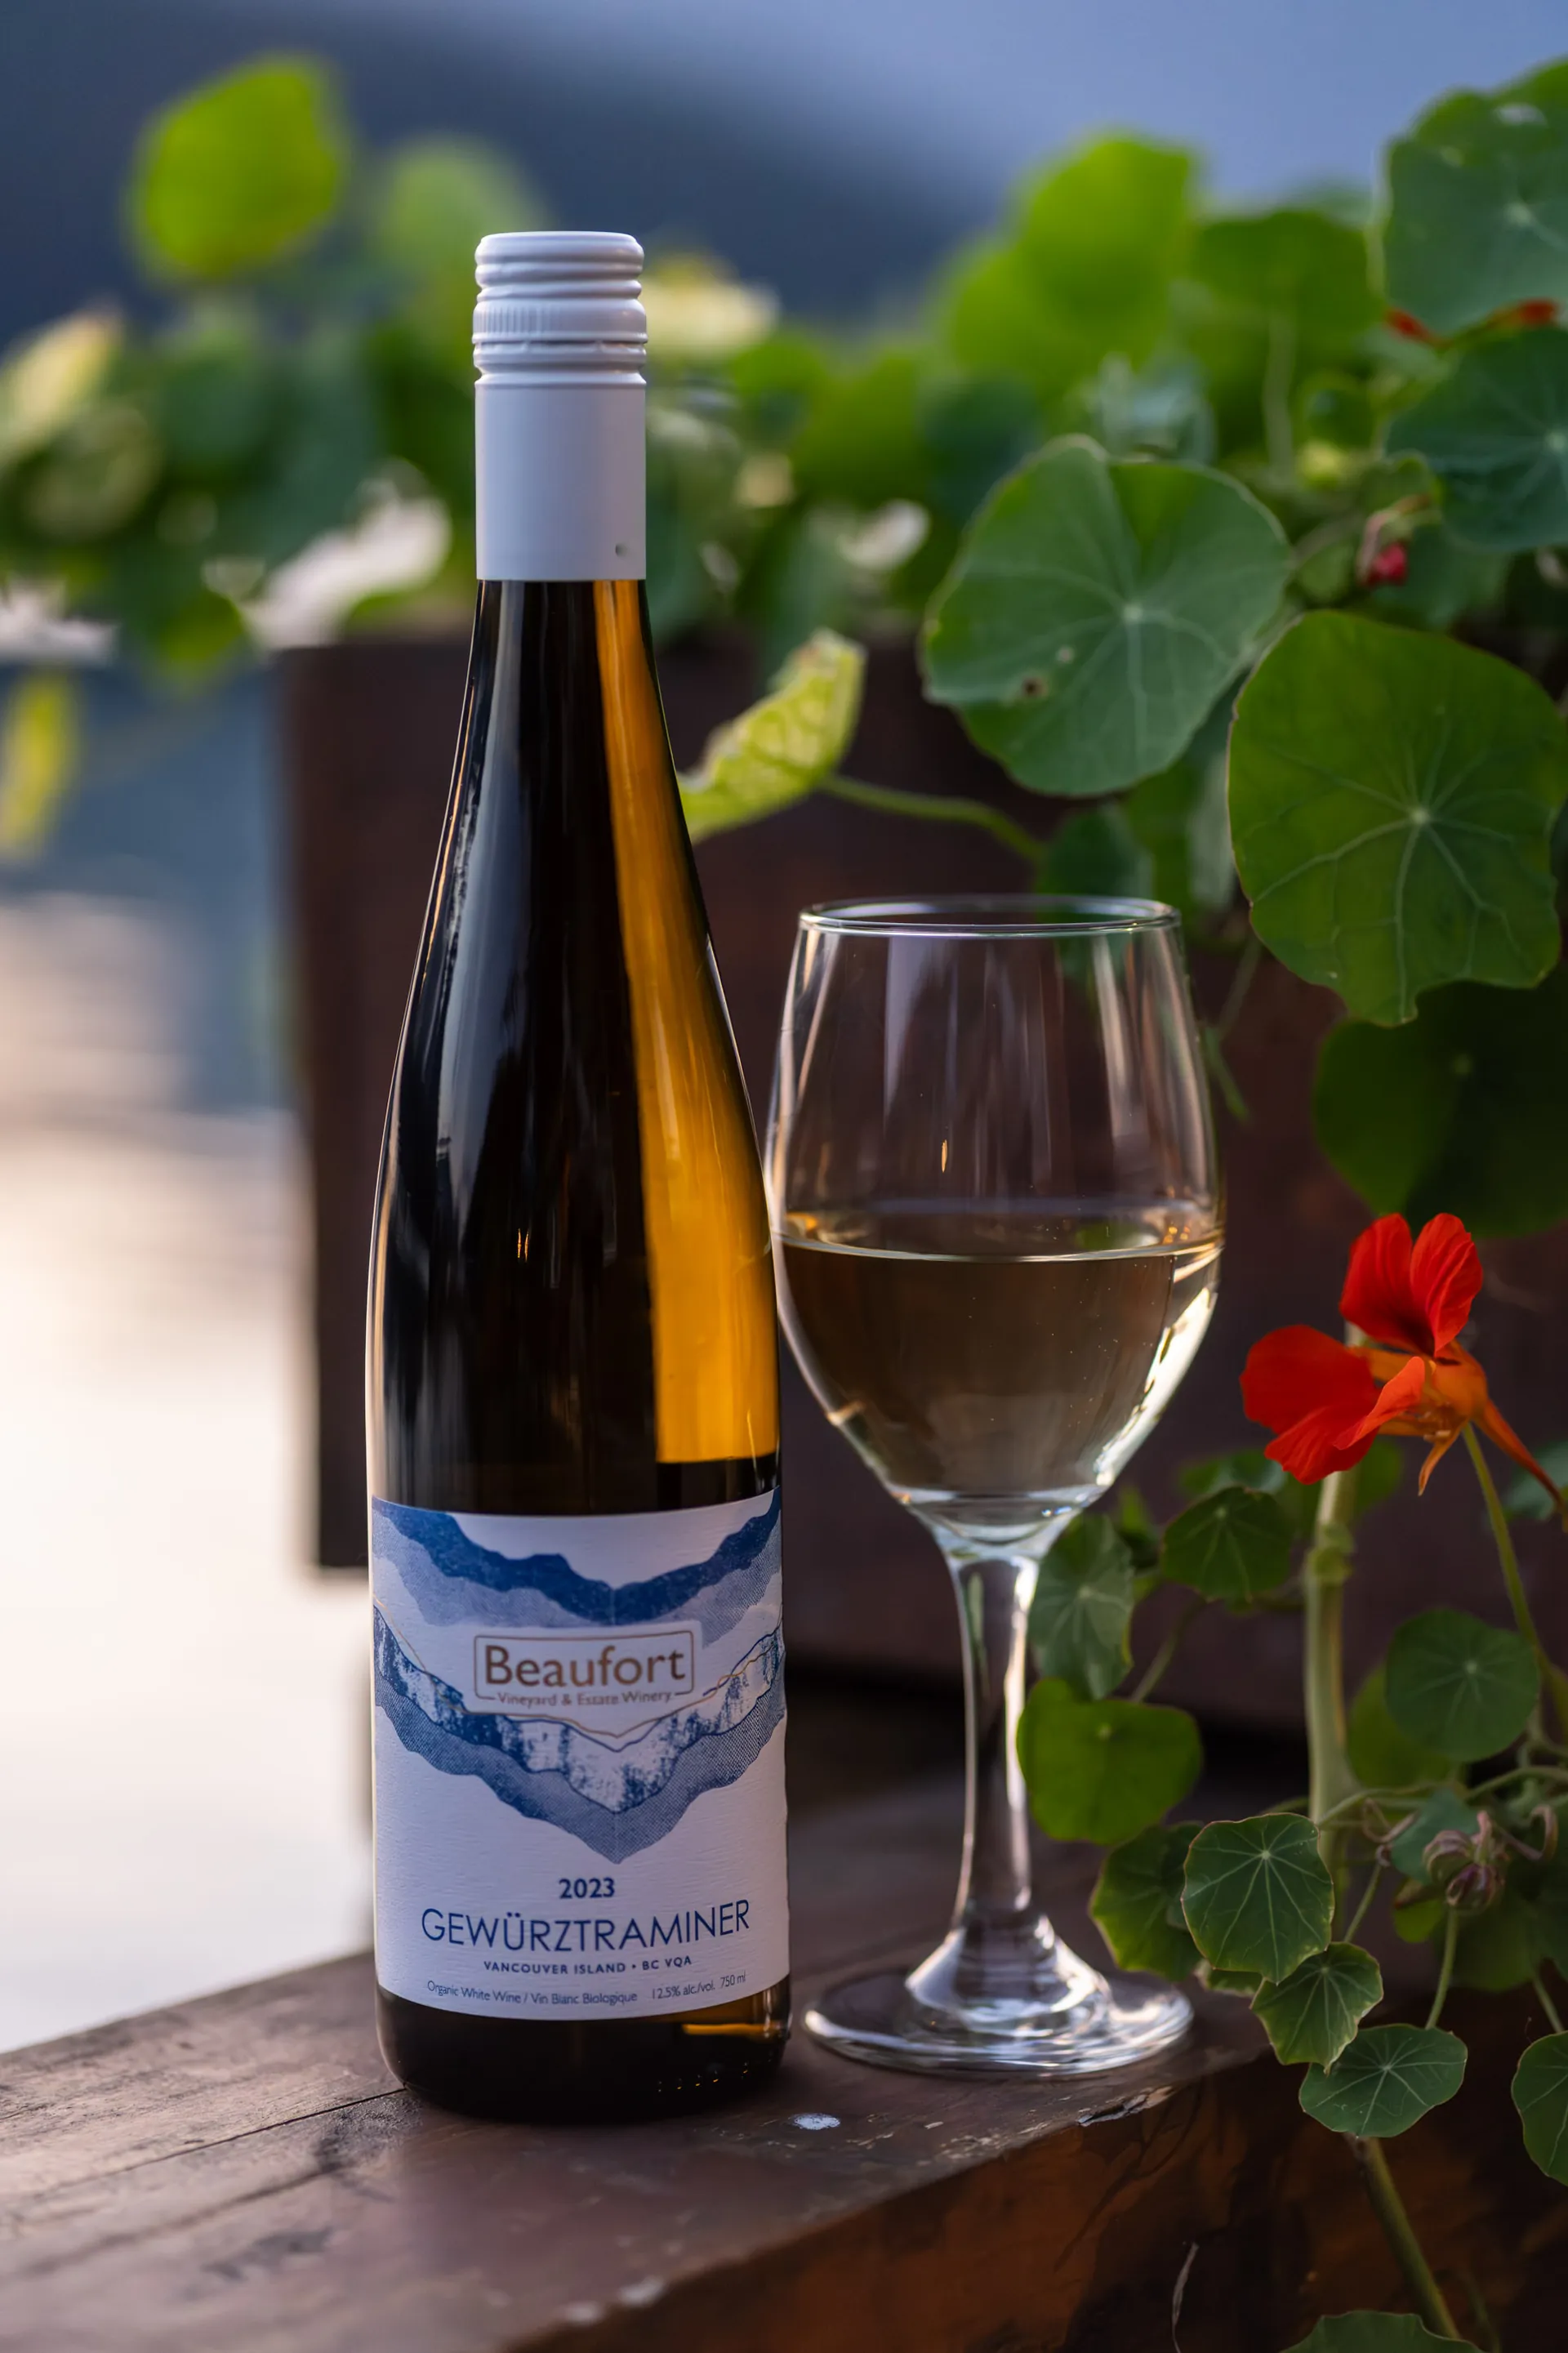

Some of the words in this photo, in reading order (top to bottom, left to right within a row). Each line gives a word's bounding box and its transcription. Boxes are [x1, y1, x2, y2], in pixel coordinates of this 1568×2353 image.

[485, 1644, 686, 1687] Beaufort
[497, 1691, 557, 1710] Vineyard
[561, 1694, 572, 1706] &
[577, 1693, 619, 1705] Estate
[621, 1691, 673, 1705] Winery
[559, 1878, 616, 1899] 2023
[421, 1899, 751, 1952] GEWÜRZTRAMINER
[483, 1961, 568, 1975] VANCOUVER
[573, 1963, 626, 1975] ISLAND
[642, 1959, 660, 1971] BC
[665, 1955, 693, 1968] VQA
[427, 1980, 459, 1997] Organic
[461, 1986, 491, 2001] White
[492, 1990, 522, 2004] Wine
[531, 1993, 549, 2004] Vin
[551, 1993, 580, 2004] Blanc
[582, 1992, 638, 2007] Biologique
[652, 1985, 682, 2000] 12.5%
[719, 1974, 736, 1989] 750
[736, 1970, 746, 1984] ml
